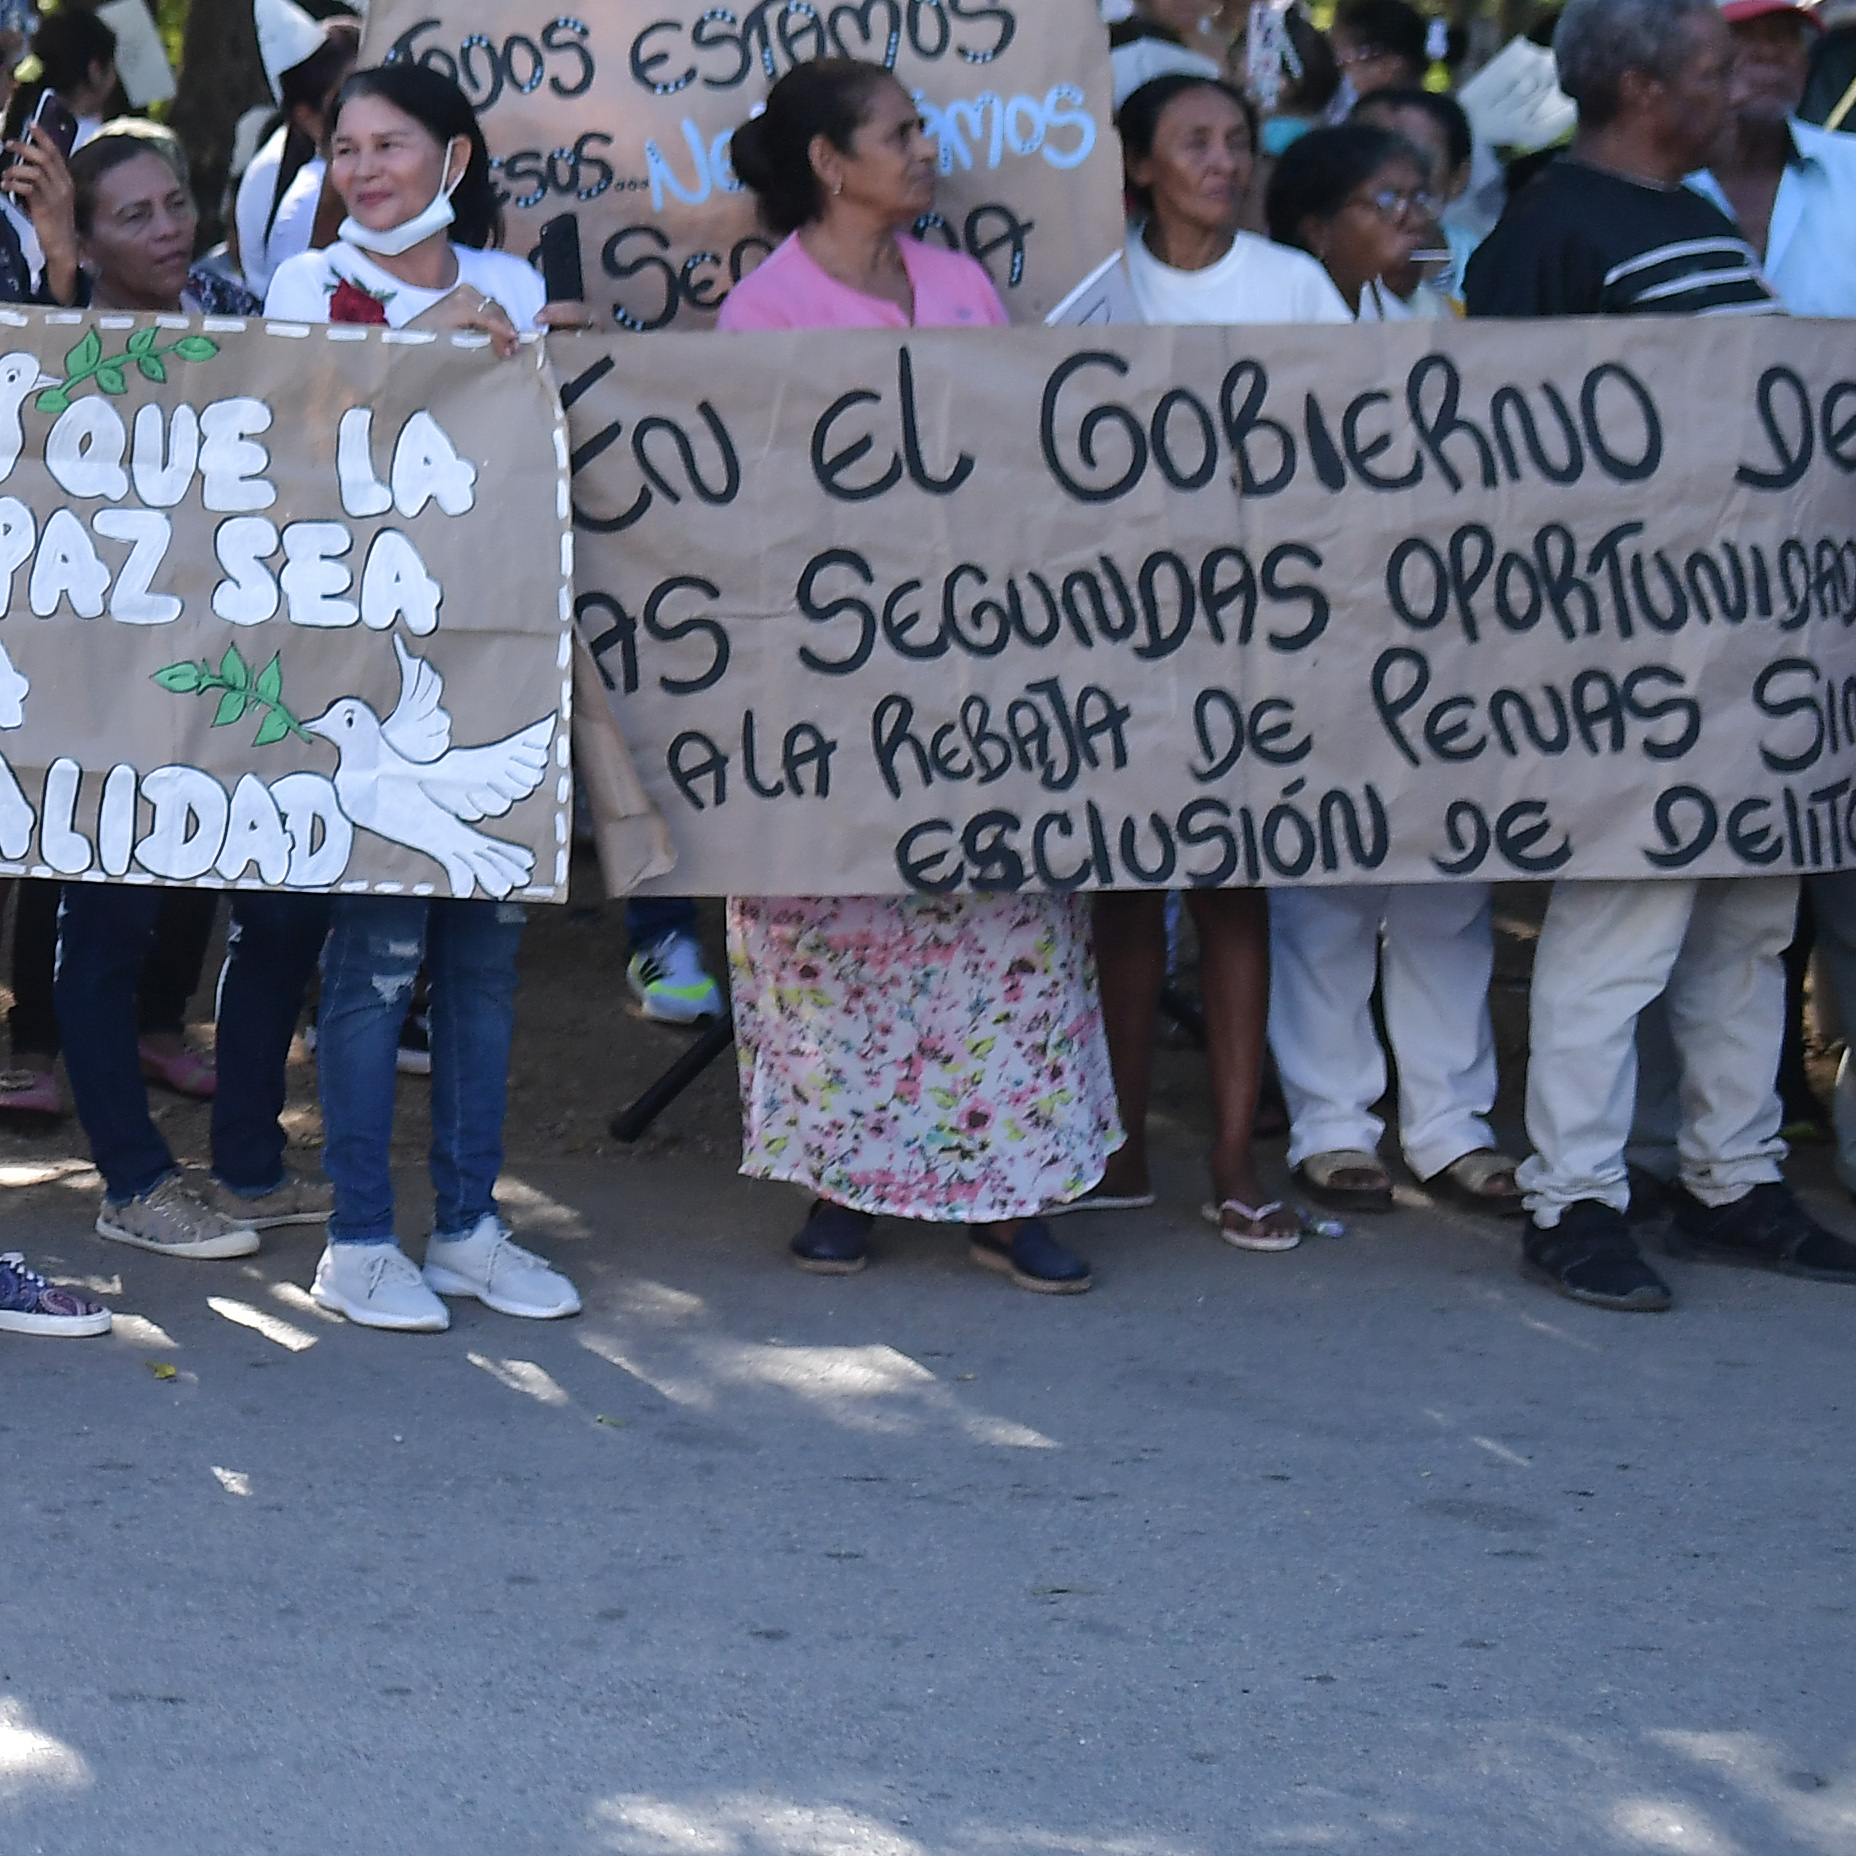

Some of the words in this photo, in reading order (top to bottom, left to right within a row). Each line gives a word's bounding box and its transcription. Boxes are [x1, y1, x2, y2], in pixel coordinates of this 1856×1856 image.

[44, 393, 278, 513] QUE
[335, 405, 479, 519] LA
[810, 344, 976, 502] EL
[1040, 349, 1664, 504] GOBIERNO
[212, 515, 445, 638] SEA
[796, 545, 1331, 675] SEGUNDAS
[871, 674, 1131, 802] REBAJA
[1190, 687, 1313, 784] DE
[1370, 645, 1702, 768] PENAS
[1429, 799, 1574, 875] DE
